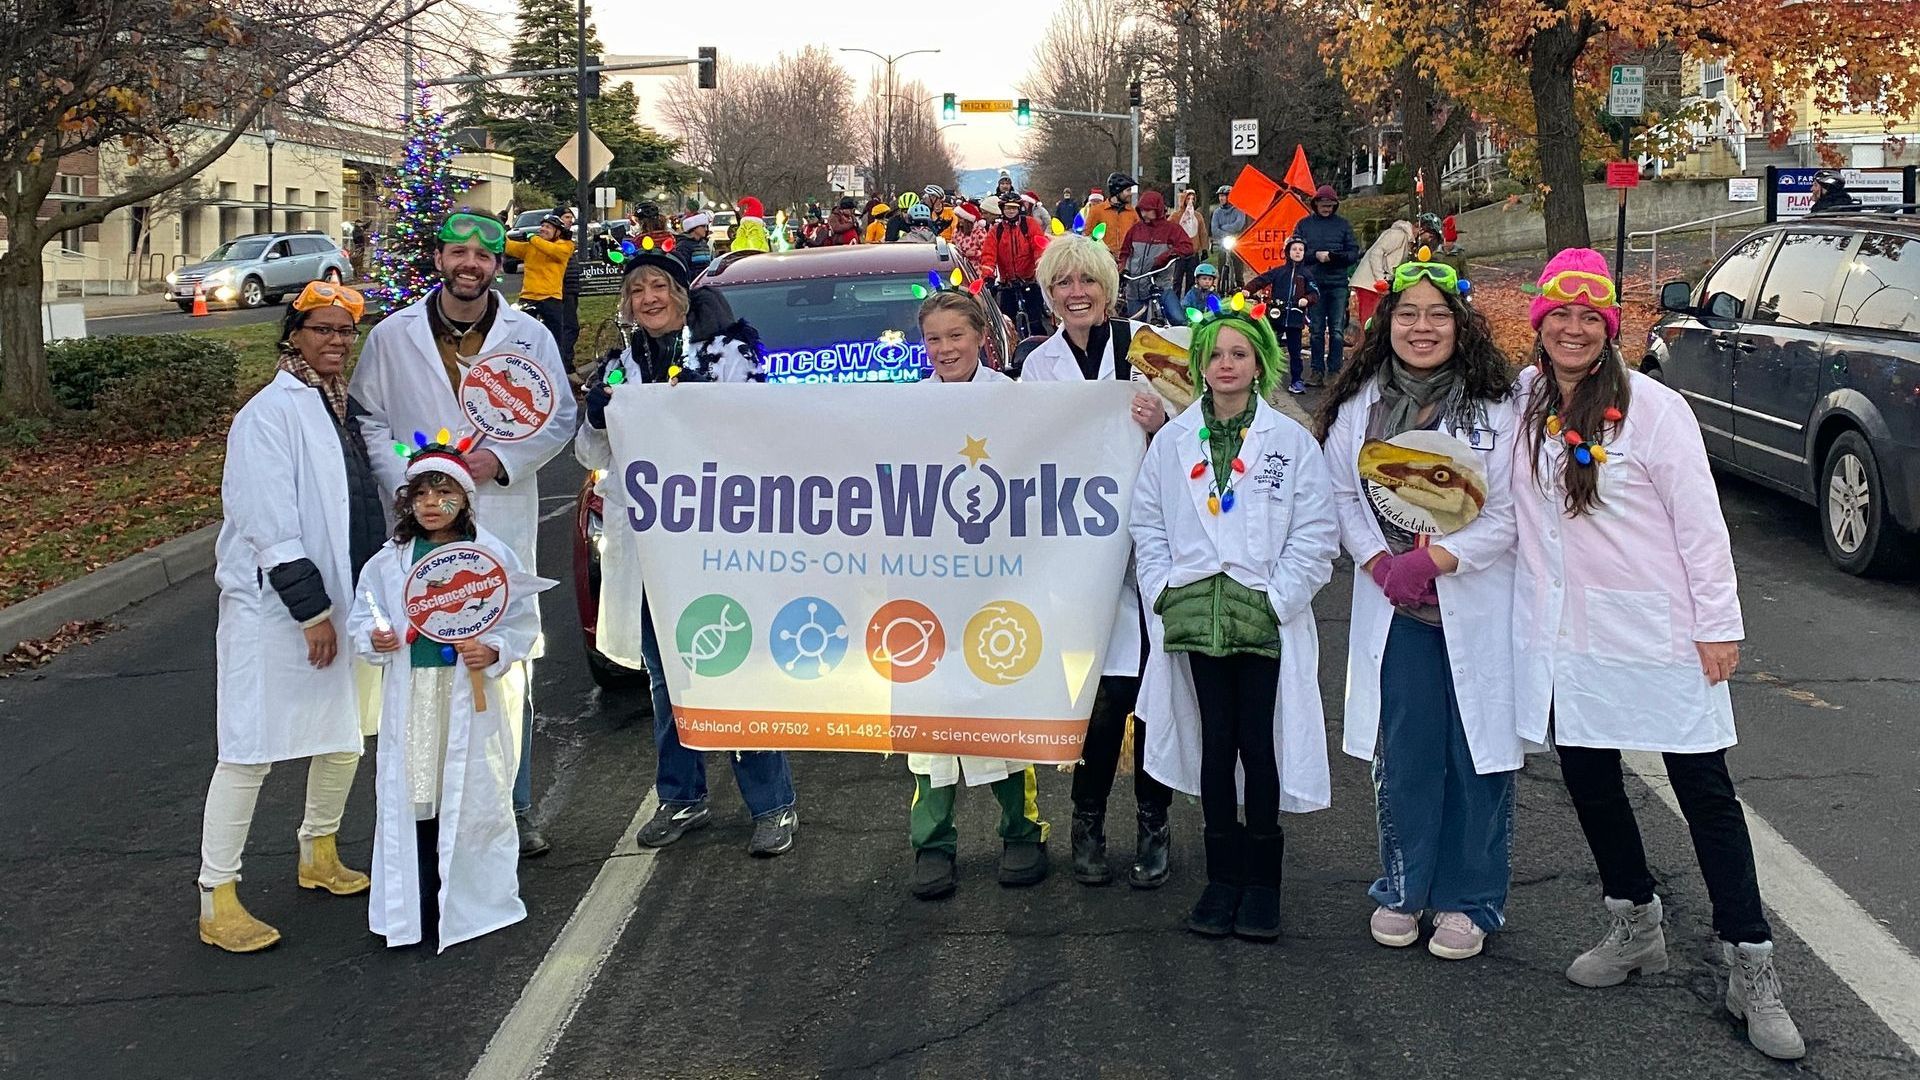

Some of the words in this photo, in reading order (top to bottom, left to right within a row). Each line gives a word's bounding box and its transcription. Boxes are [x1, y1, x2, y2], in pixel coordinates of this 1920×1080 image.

[1613, 71, 1620, 83] 2
[1233, 123, 1257, 131] SPEED
[1234, 134, 1256, 149] 25
[1257, 230, 1287, 243] LEFT
[505, 356, 522, 367] Gift
[521, 363, 540, 381] Shop
[538, 380, 550, 398] Sale
[838, 368, 921, 383] MUSEUM
[471, 366, 541, 427] @ScienceWorks
[465, 400, 478, 416] Gift
[475, 414, 494, 433] Shop
[494, 428, 514, 438] Sale
[624, 459, 1120, 544] ScienceWorks
[1369, 484, 1437, 534] Austriadactylus
[415, 563, 433, 580] Gift
[431, 553, 456, 569] Shop
[458, 551, 480, 561] Sale
[702, 548, 867, 576] HANDS-ON
[881, 552, 1024, 578] MUSEUM
[406, 575, 503, 617] @ScienceWorks
[438, 628, 456, 637] Gift
[457, 621, 482, 636] Shop
[481, 606, 500, 625] Sale
[691, 719, 745, 735] Ashland,
[748, 721, 770, 735] OR
[771, 722, 809, 736] 97502
[826, 722, 918, 739] 541-482-6767
